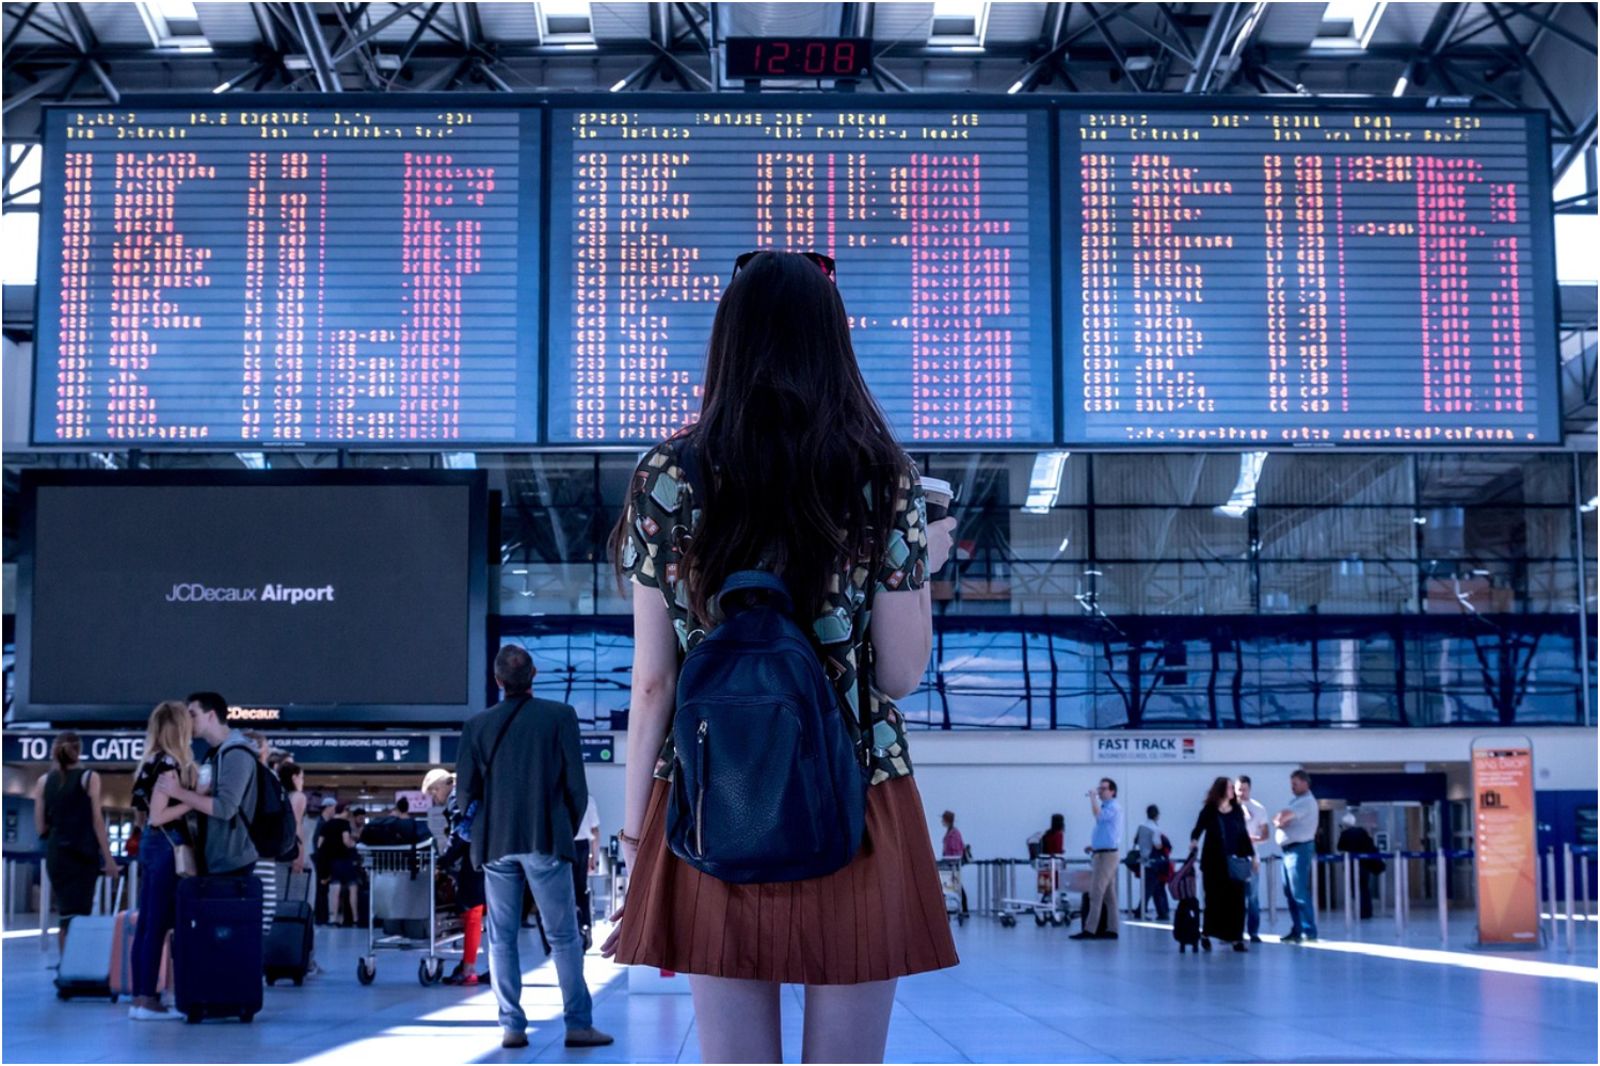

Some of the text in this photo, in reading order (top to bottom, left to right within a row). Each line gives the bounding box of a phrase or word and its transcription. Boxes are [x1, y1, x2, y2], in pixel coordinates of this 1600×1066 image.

[754, 42, 855, 74] 12:08
[165, 583, 335, 605] JCDecaux Airport
[18, 737, 144, 760] TO GATE
[292, 738, 323, 747] PASSPORT
[324, 738, 338, 747] AND
[338, 738, 370, 747] BOARDING
[371, 738, 387, 747] PASS
[387, 738, 409, 747] READY
[1097, 738, 1177, 751] FAST TRACK
